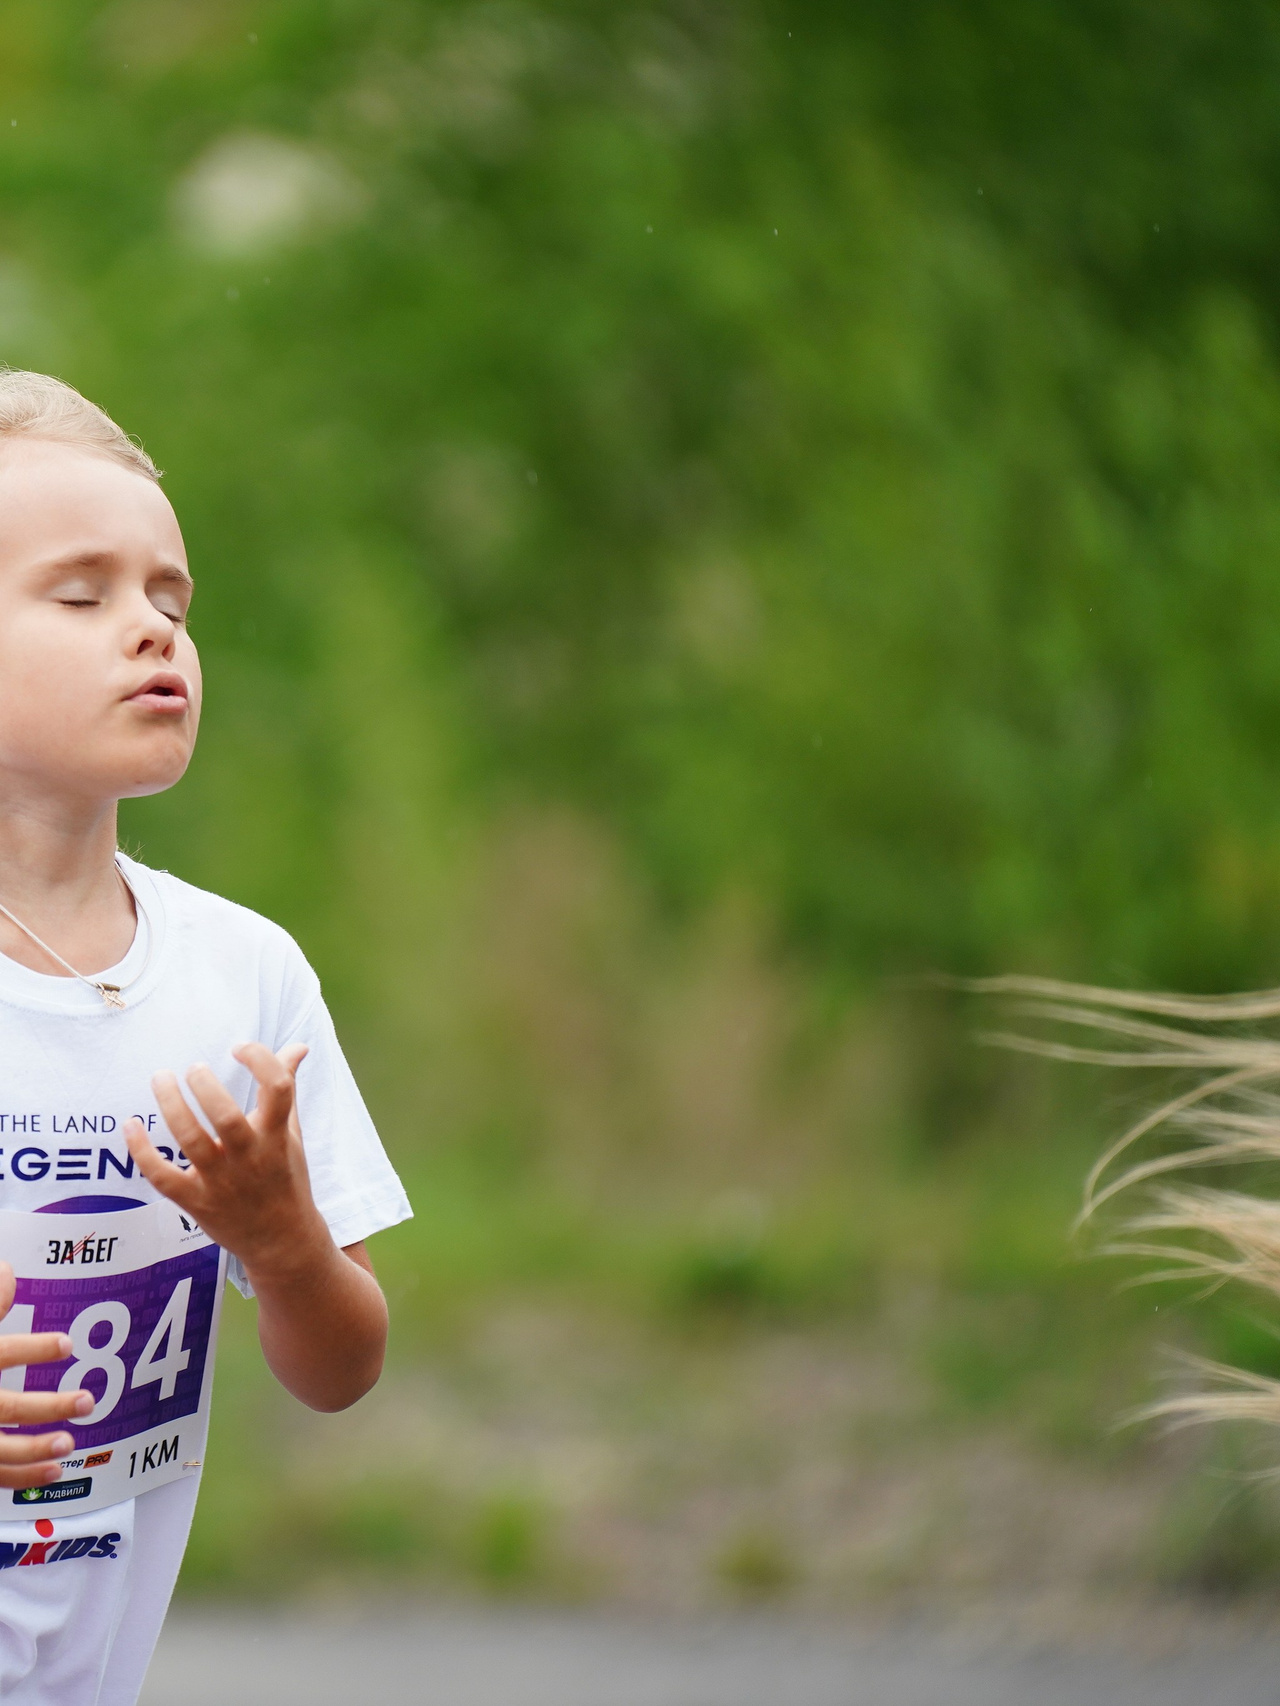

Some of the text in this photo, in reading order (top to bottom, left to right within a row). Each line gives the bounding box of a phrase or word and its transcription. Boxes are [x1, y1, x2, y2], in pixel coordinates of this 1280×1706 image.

[52, 1115, 116, 1133] LAND
[86, 1452, 112, 1467] PRO
[129, 1451, 137, 1479] 1
[43, 1486, 85, 1499] Гудвилл
